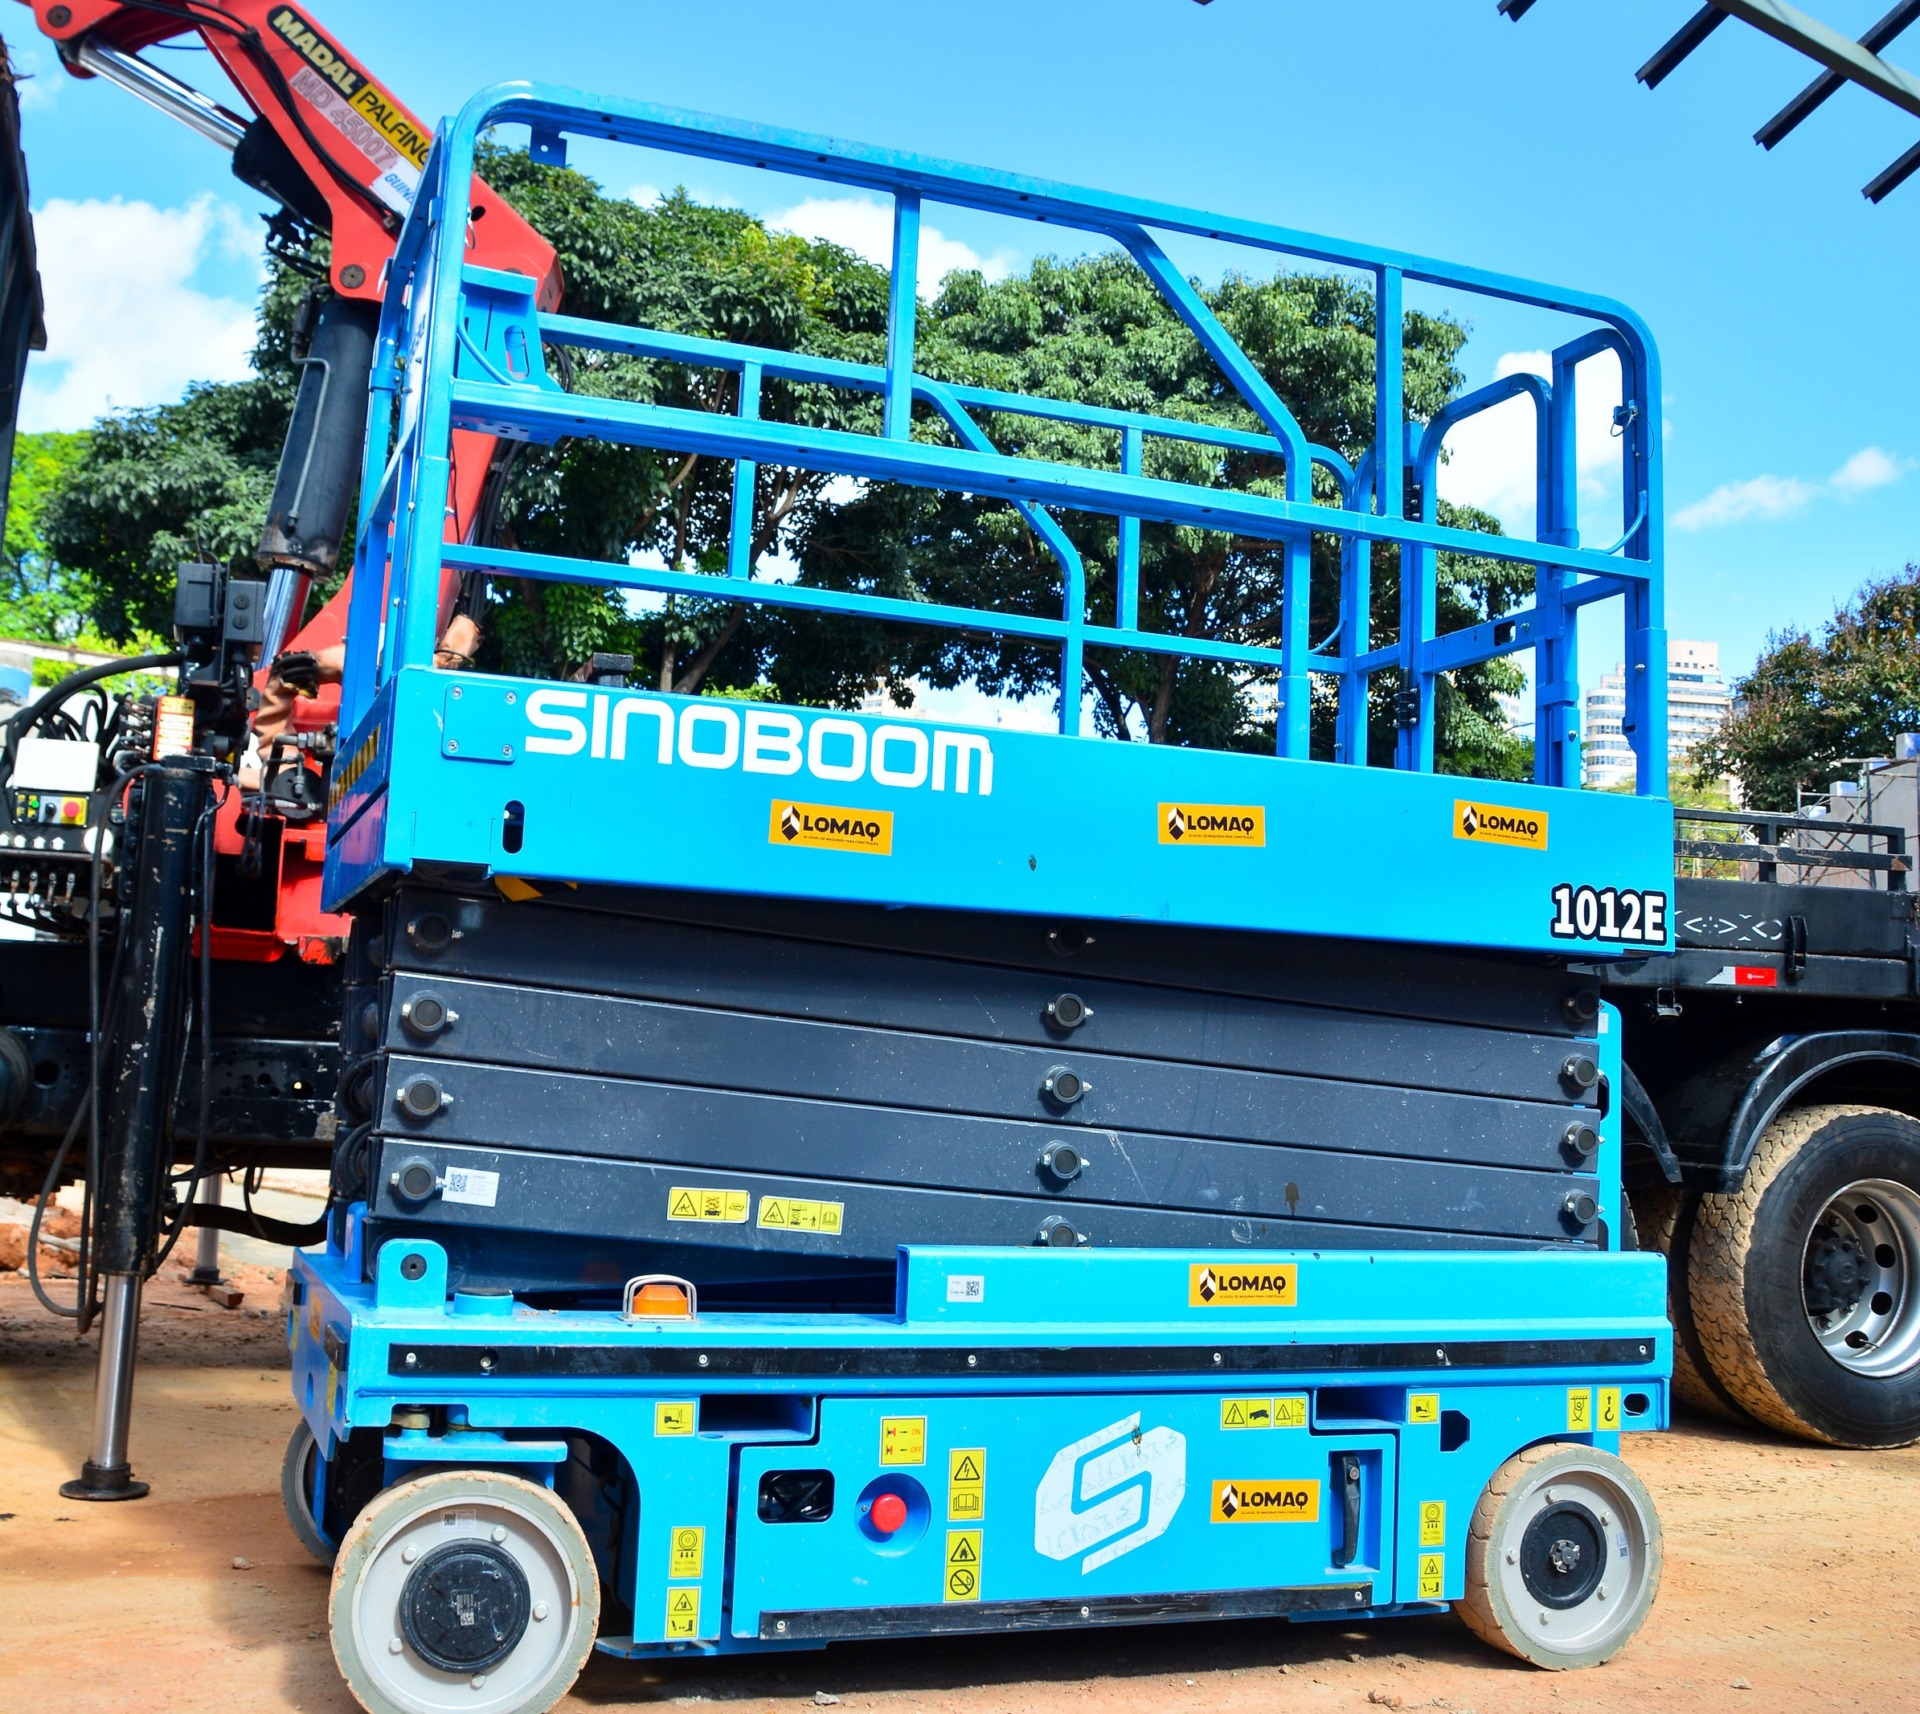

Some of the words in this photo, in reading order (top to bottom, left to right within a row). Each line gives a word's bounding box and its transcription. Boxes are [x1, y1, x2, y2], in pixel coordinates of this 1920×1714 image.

[272, 9, 358, 95] MADAL
[292, 68, 334, 108] MD
[331, 107, 398, 164] 45007
[525, 688, 994, 797] SINOBOOM
[803, 815, 880, 842] LOMAQ
[1187, 815, 1255, 835] LOMAQ
[1480, 814, 1538, 838] LOMAQ
[1552, 885, 1666, 944] 1012E
[1219, 1275, 1286, 1294] LOMAQ
[1241, 1491, 1308, 1510] LOMAQ
